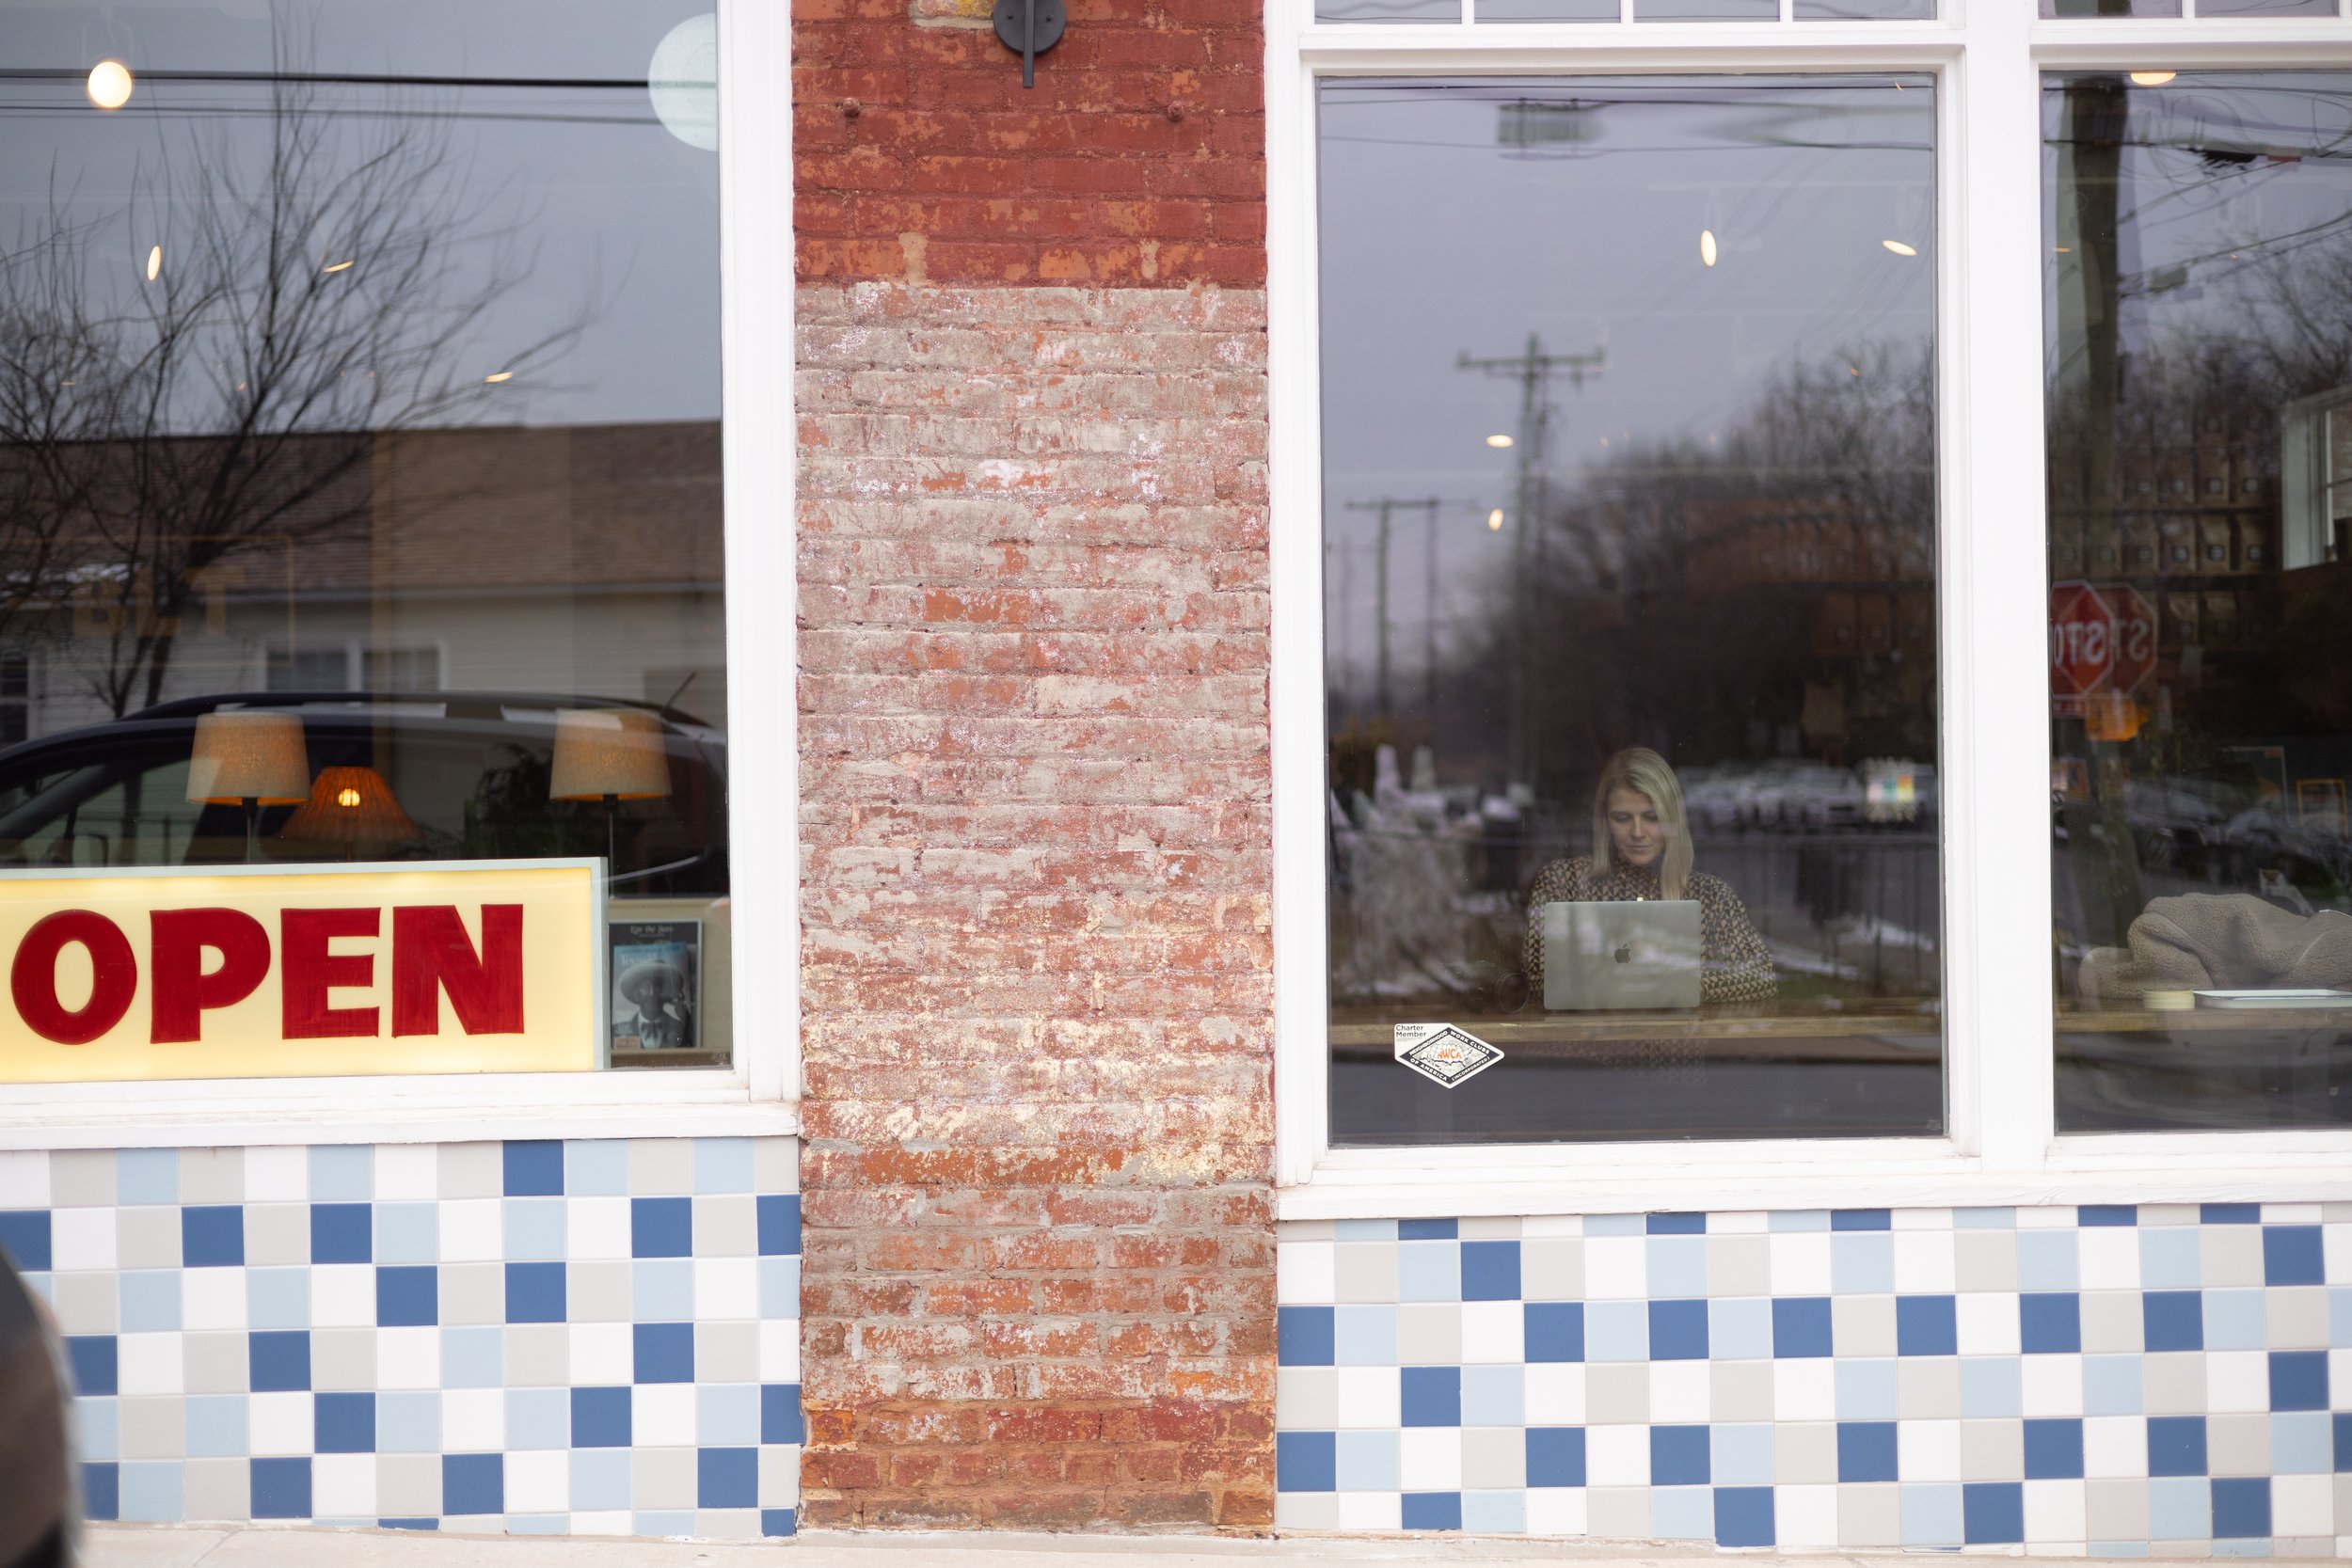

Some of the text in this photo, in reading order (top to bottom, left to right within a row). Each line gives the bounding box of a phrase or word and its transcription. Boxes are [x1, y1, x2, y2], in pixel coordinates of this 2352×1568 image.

[11, 904, 525, 1045] OPEN
[1408, 1030, 1448, 1055] NEIGHBORHOOD
[1438, 1048, 1462, 1059] NWCA
[1450, 1030, 1490, 1054] WORK CLUBS
[1420, 1064, 1448, 1082] AMERICA
[1452, 1055, 1490, 1081] (INCORPORATED)
